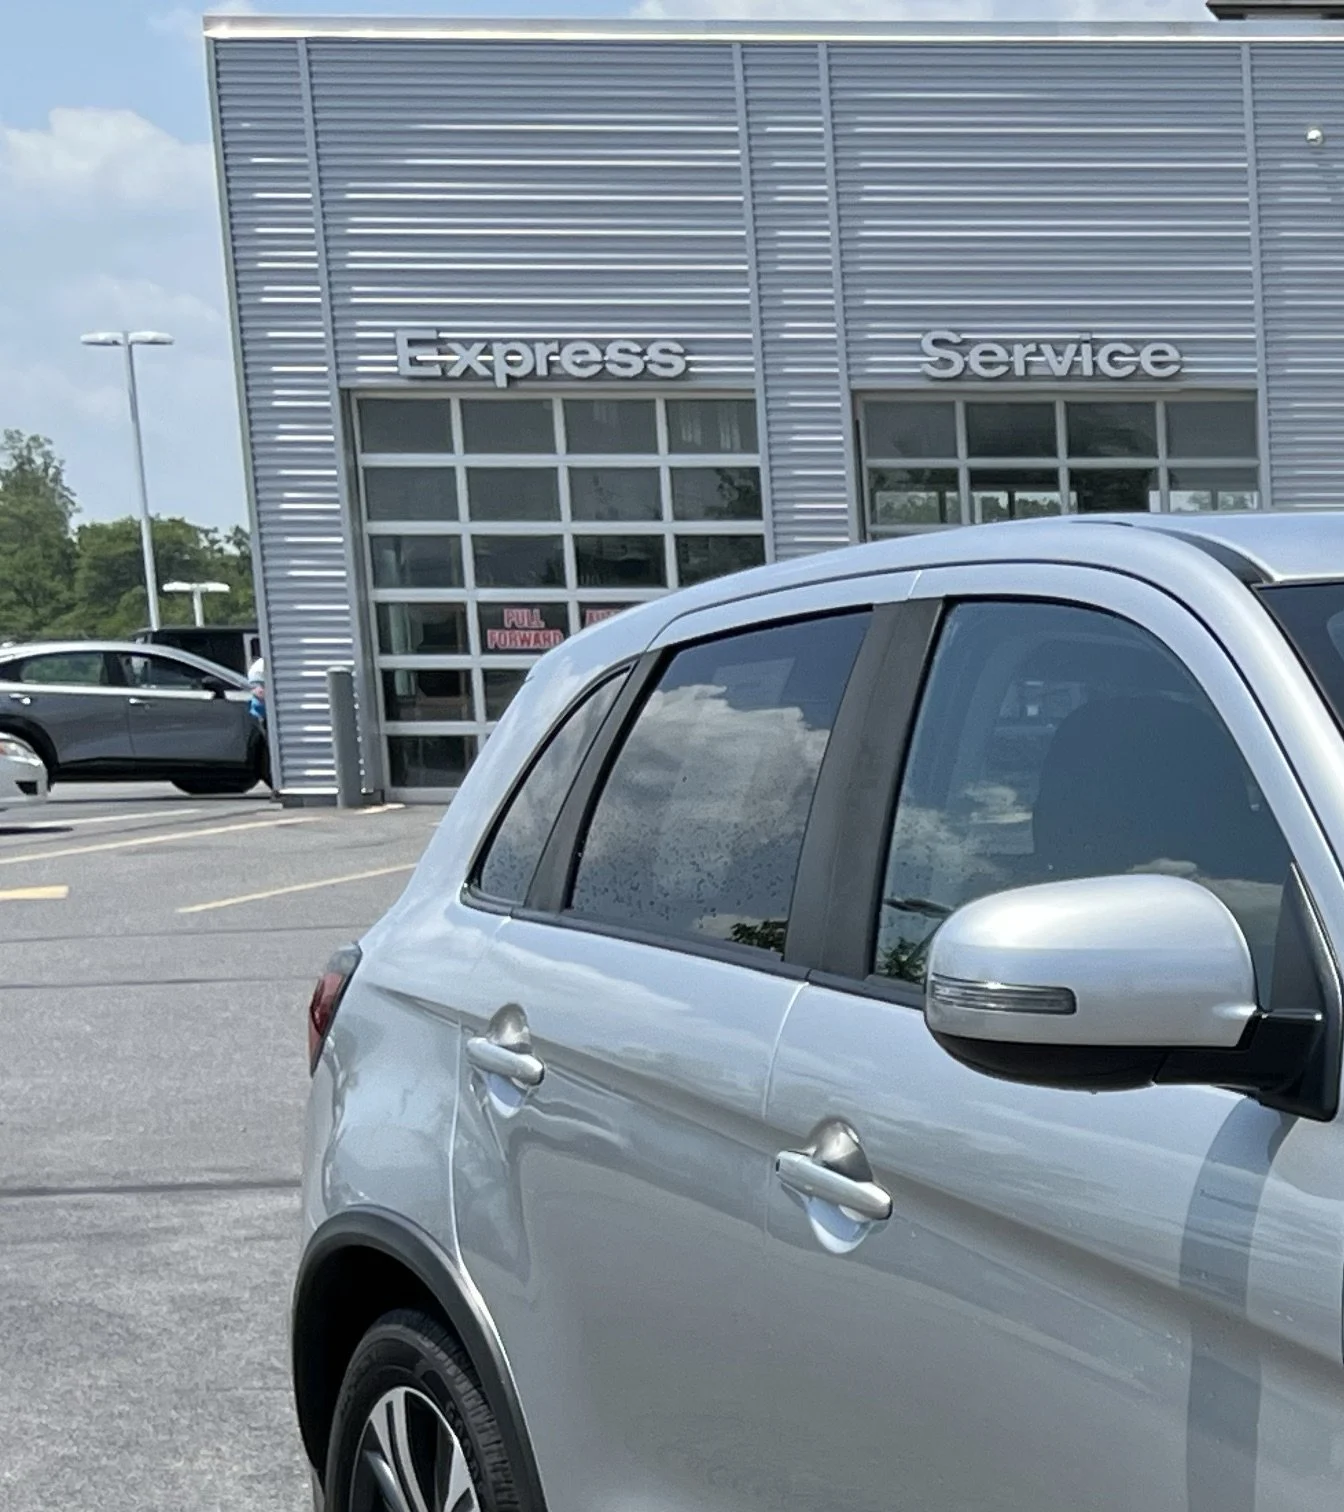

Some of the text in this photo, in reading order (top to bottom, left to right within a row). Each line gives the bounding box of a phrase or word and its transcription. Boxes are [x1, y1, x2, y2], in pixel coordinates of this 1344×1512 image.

[395, 328, 688, 388] Express
[920, 329, 1183, 380] Service
[504, 608, 545, 629] PULL
[487, 629, 565, 649] FORWARD
